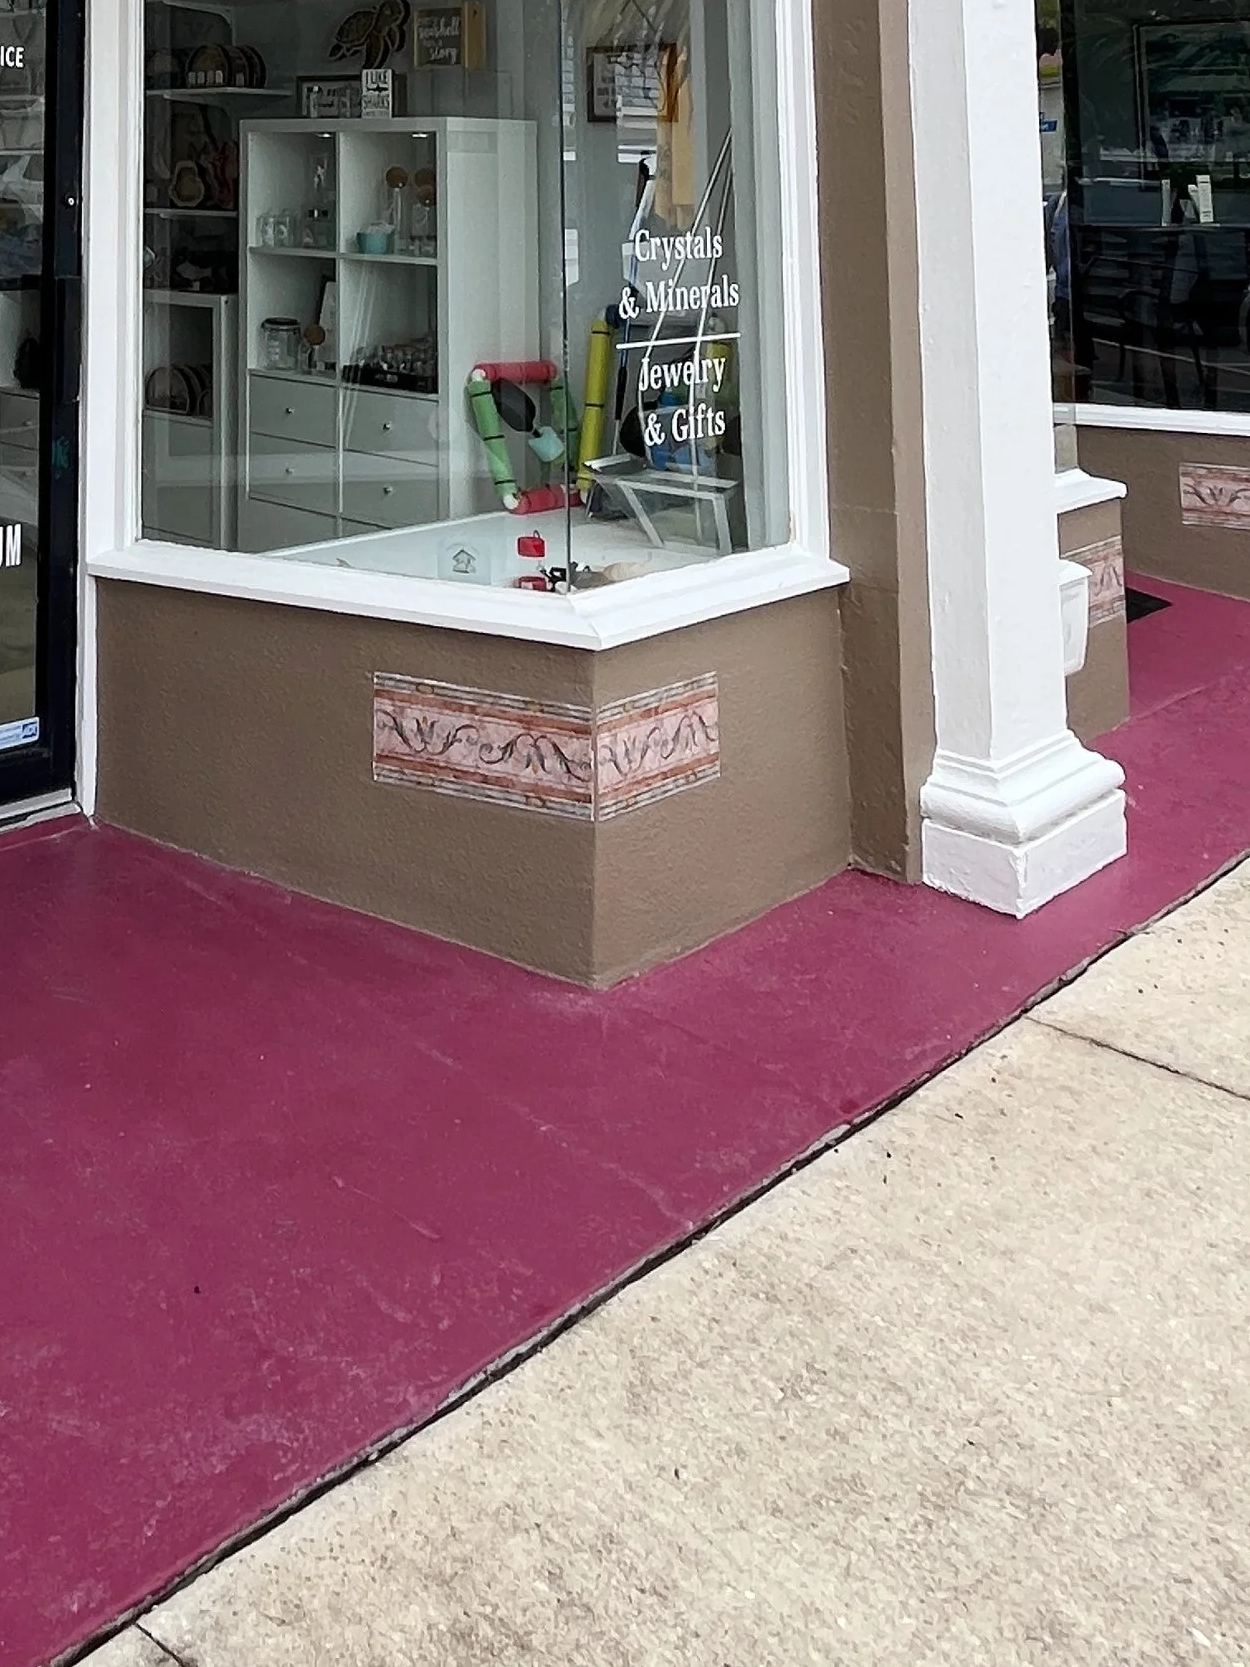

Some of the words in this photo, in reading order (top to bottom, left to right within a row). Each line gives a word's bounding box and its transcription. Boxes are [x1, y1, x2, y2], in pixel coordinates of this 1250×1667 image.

[633, 225, 723, 271] Crystals
[618, 288, 640, 320] &
[645, 274, 740, 314] Minerals
[638, 355, 727, 393] Jewelry
[643, 412, 667, 447] &
[671, 404, 726, 442] Gifts
